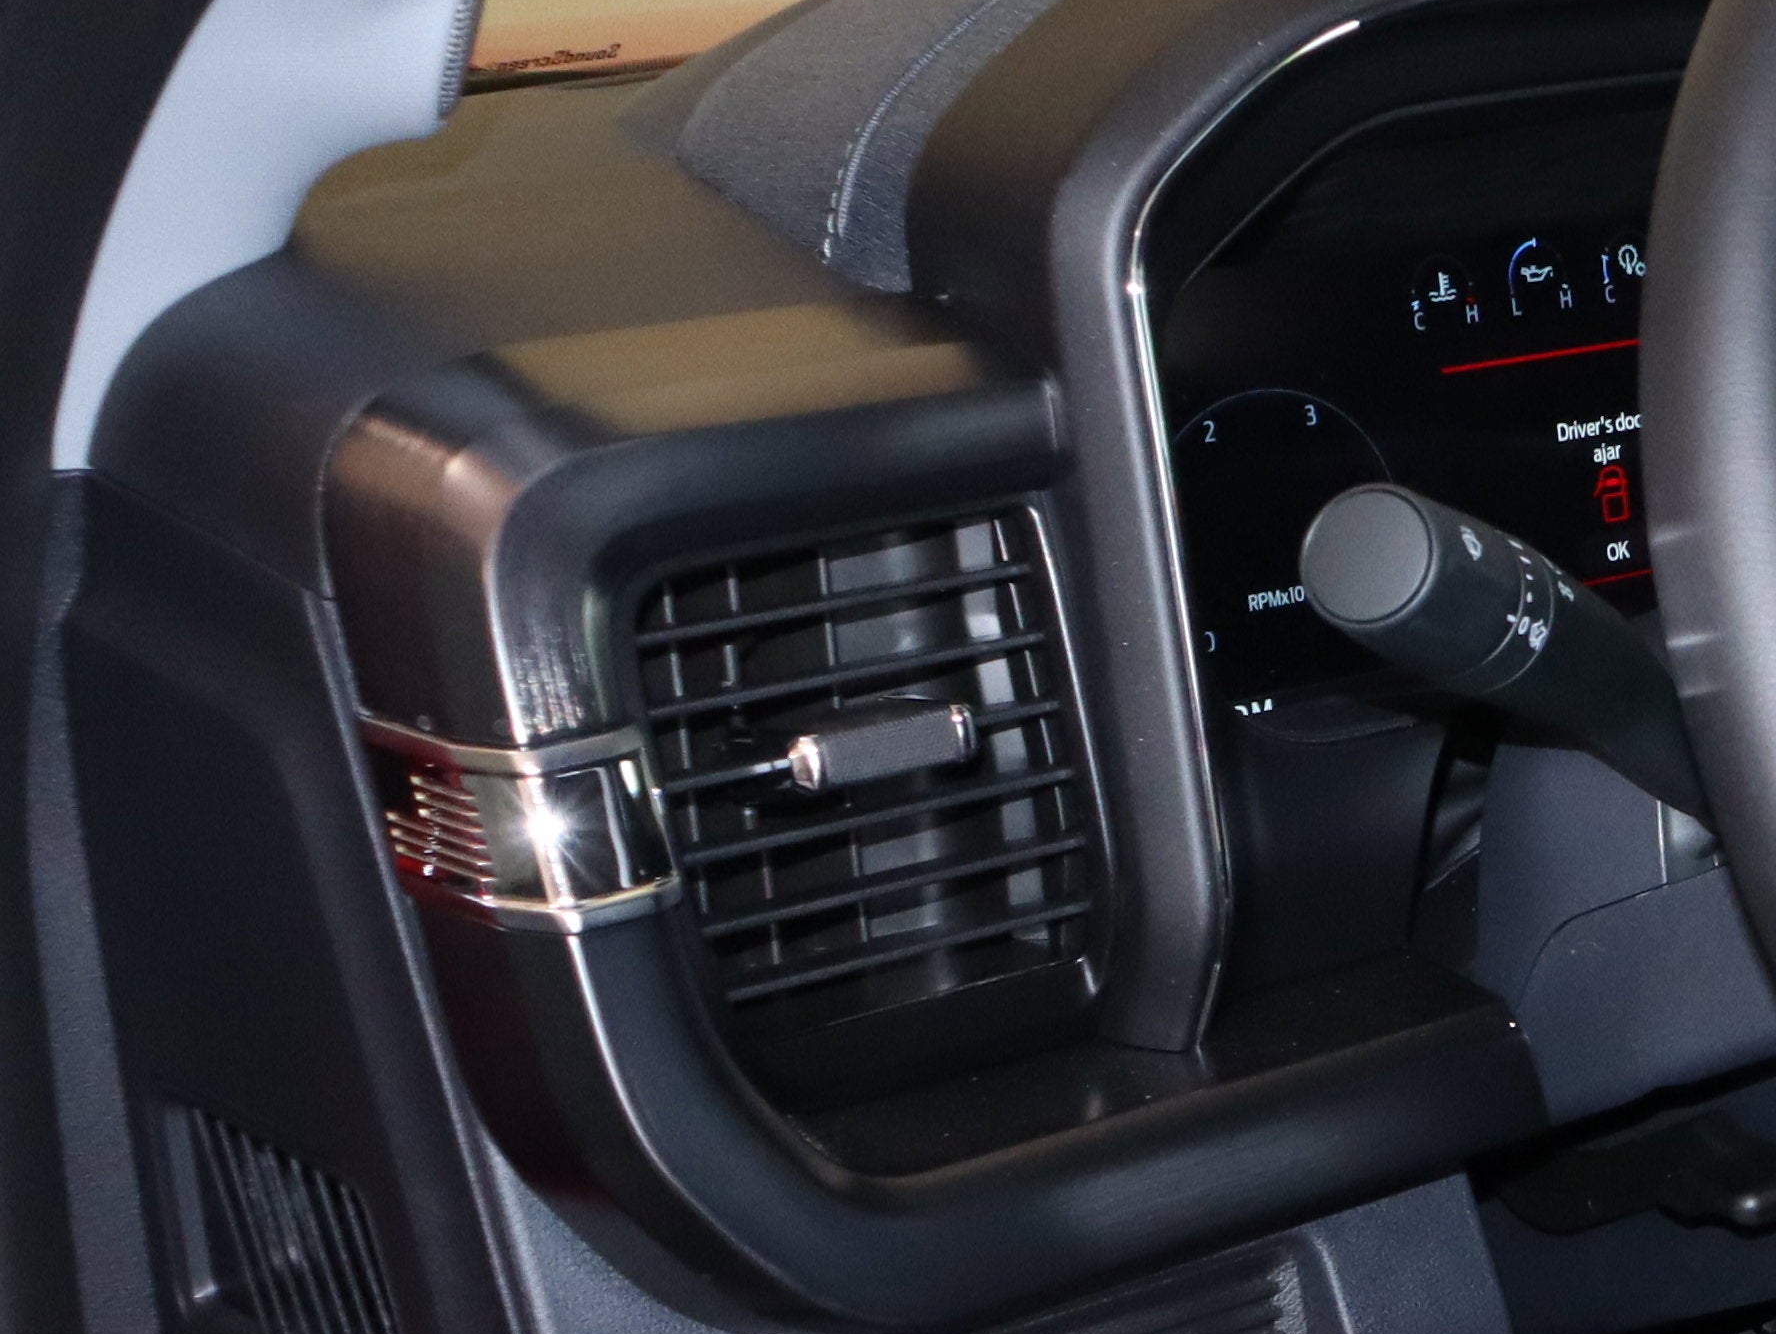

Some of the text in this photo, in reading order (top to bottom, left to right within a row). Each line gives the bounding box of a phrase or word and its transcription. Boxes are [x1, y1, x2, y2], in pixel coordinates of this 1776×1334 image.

[1511, 289, 1573, 317] L H
[1605, 285, 1616, 304] C
[1413, 304, 1479, 331] C H
[1303, 404, 1318, 427] 3
[1556, 412, 1641, 442] Driver's doo
[1203, 420, 1217, 443] 2
[1593, 443, 1621, 465] ajar
[1606, 540, 1631, 561] OK
[1248, 585, 1304, 612] RPMx10
